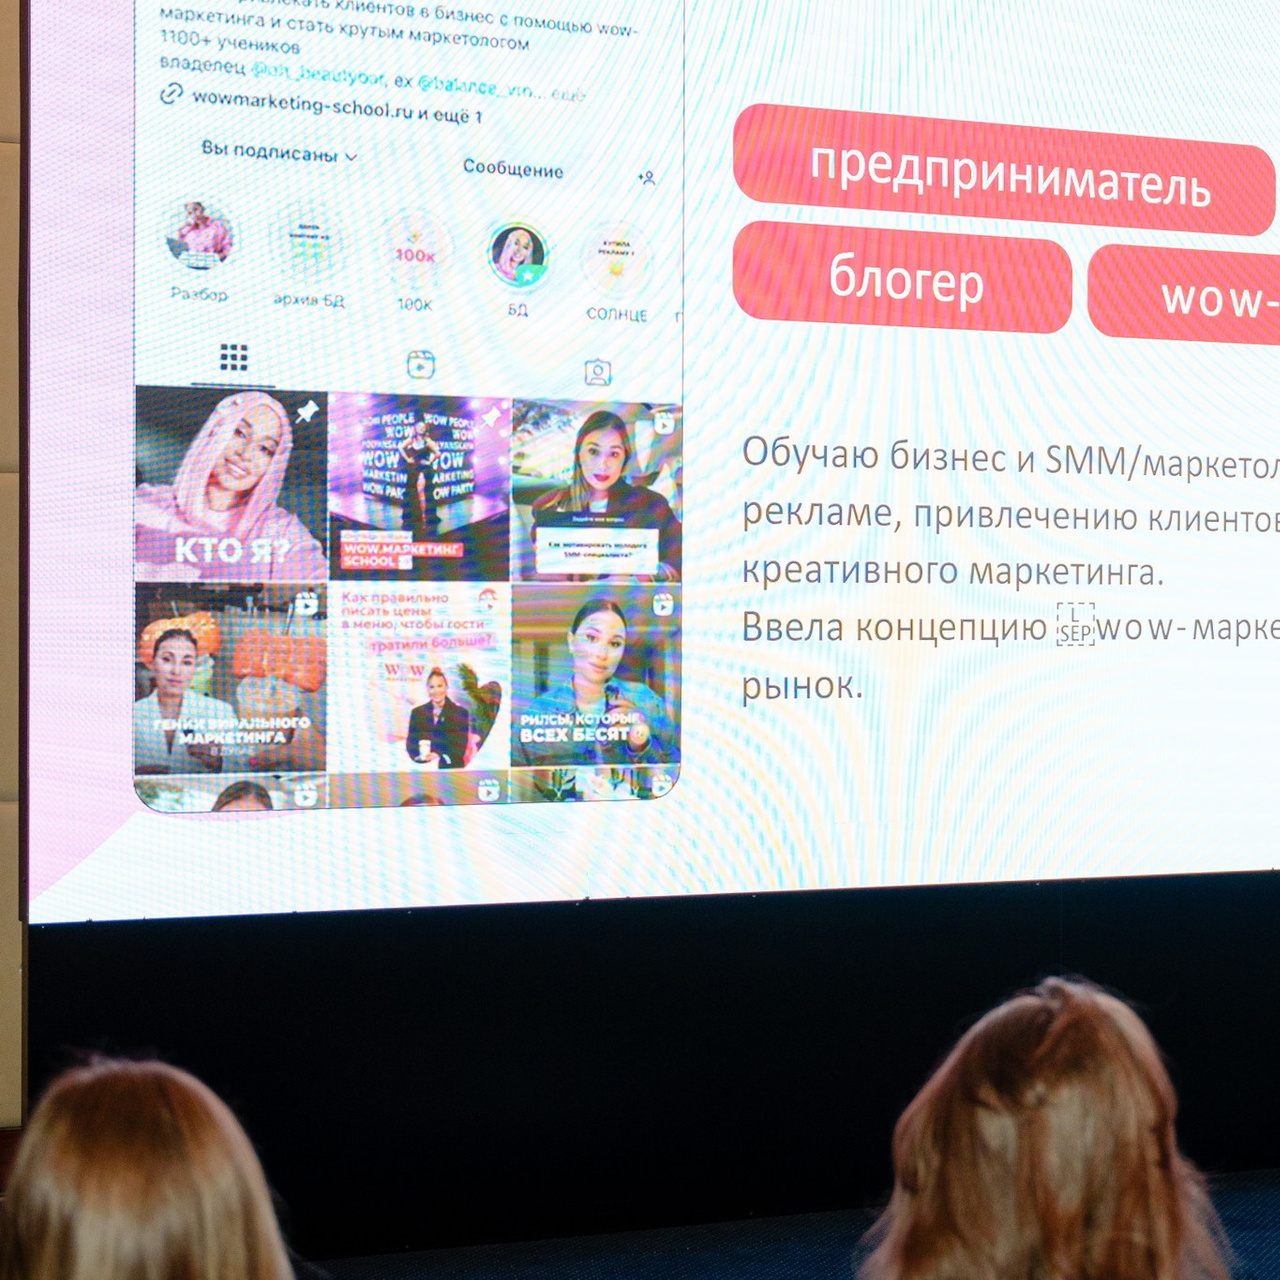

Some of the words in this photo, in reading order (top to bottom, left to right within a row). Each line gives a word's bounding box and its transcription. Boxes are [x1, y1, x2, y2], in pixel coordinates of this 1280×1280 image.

[160, 7, 265, 28] маркетинга
[271, 17, 281, 28] и
[287, 18, 334, 33] стать
[339, 22, 403, 39] крутым
[409, 28, 530, 50] маркетологом
[336, 0, 415, 17] клиентов
[421, 8, 429, 18] в
[435, 5, 494, 25] бизнес
[499, 14, 509, 26] с
[514, 16, 592, 34] помощью
[597, 23, 638, 37] wow-
[161, 29, 211, 45] 1100+
[218, 35, 300, 54] учеников
[160, 56, 247, 75] владелец
[394, 75, 413, 87] ex
[192, 90, 413, 120] wowmarketing-school.ru
[418, 109, 428, 120] и
[434, 108, 469, 125] ещё
[476, 111, 482, 123] 1
[201, 140, 228, 155] Вы
[234, 145, 338, 162] подписаны
[464, 159, 563, 180] Сообщение
[811, 139, 1211, 210] предприниматель
[831, 252, 983, 312] блогер
[171, 287, 228, 302] Разбор
[274, 294, 318, 306] архив
[324, 294, 345, 309] БД
[508, 303, 528, 317] БД
[586, 307, 647, 323] СОЛНЦЕ
[744, 436, 878, 474] Обучаю
[891, 440, 1005, 471] бизнес
[1019, 451, 1033, 472] и
[742, 500, 902, 535] рекламе,
[916, 505, 1137, 534] привлечению
[174, 537, 243, 563] КТО
[250, 538, 292, 564] Я?
[344, 556, 395, 566] SCHOOL
[744, 560, 957, 590] креативного
[970, 563, 1164, 591] маркетинга.
[343, 592, 367, 603] Как
[372, 593, 449, 605] правильно
[342, 607, 389, 616] писать
[394, 607, 432, 618] цены
[354, 620, 397, 631] меню,
[400, 619, 444, 629] чтобы
[447, 620, 485, 629] гости
[744, 611, 842, 641] Ввела
[858, 619, 1046, 648] концепцию
[371, 641, 428, 653] тратили
[431, 634, 492, 648] больше?
[744, 677, 861, 707] рынок.
[207, 716, 311, 730] ВИРАЛЬНОГО
[576, 713, 640, 725] КОТОРЫЕ
[178, 732, 286, 744] МАРКЕТИНГА
[520, 727, 569, 743] ВСЕХ
[573, 726, 630, 741] БЕСЯТ
